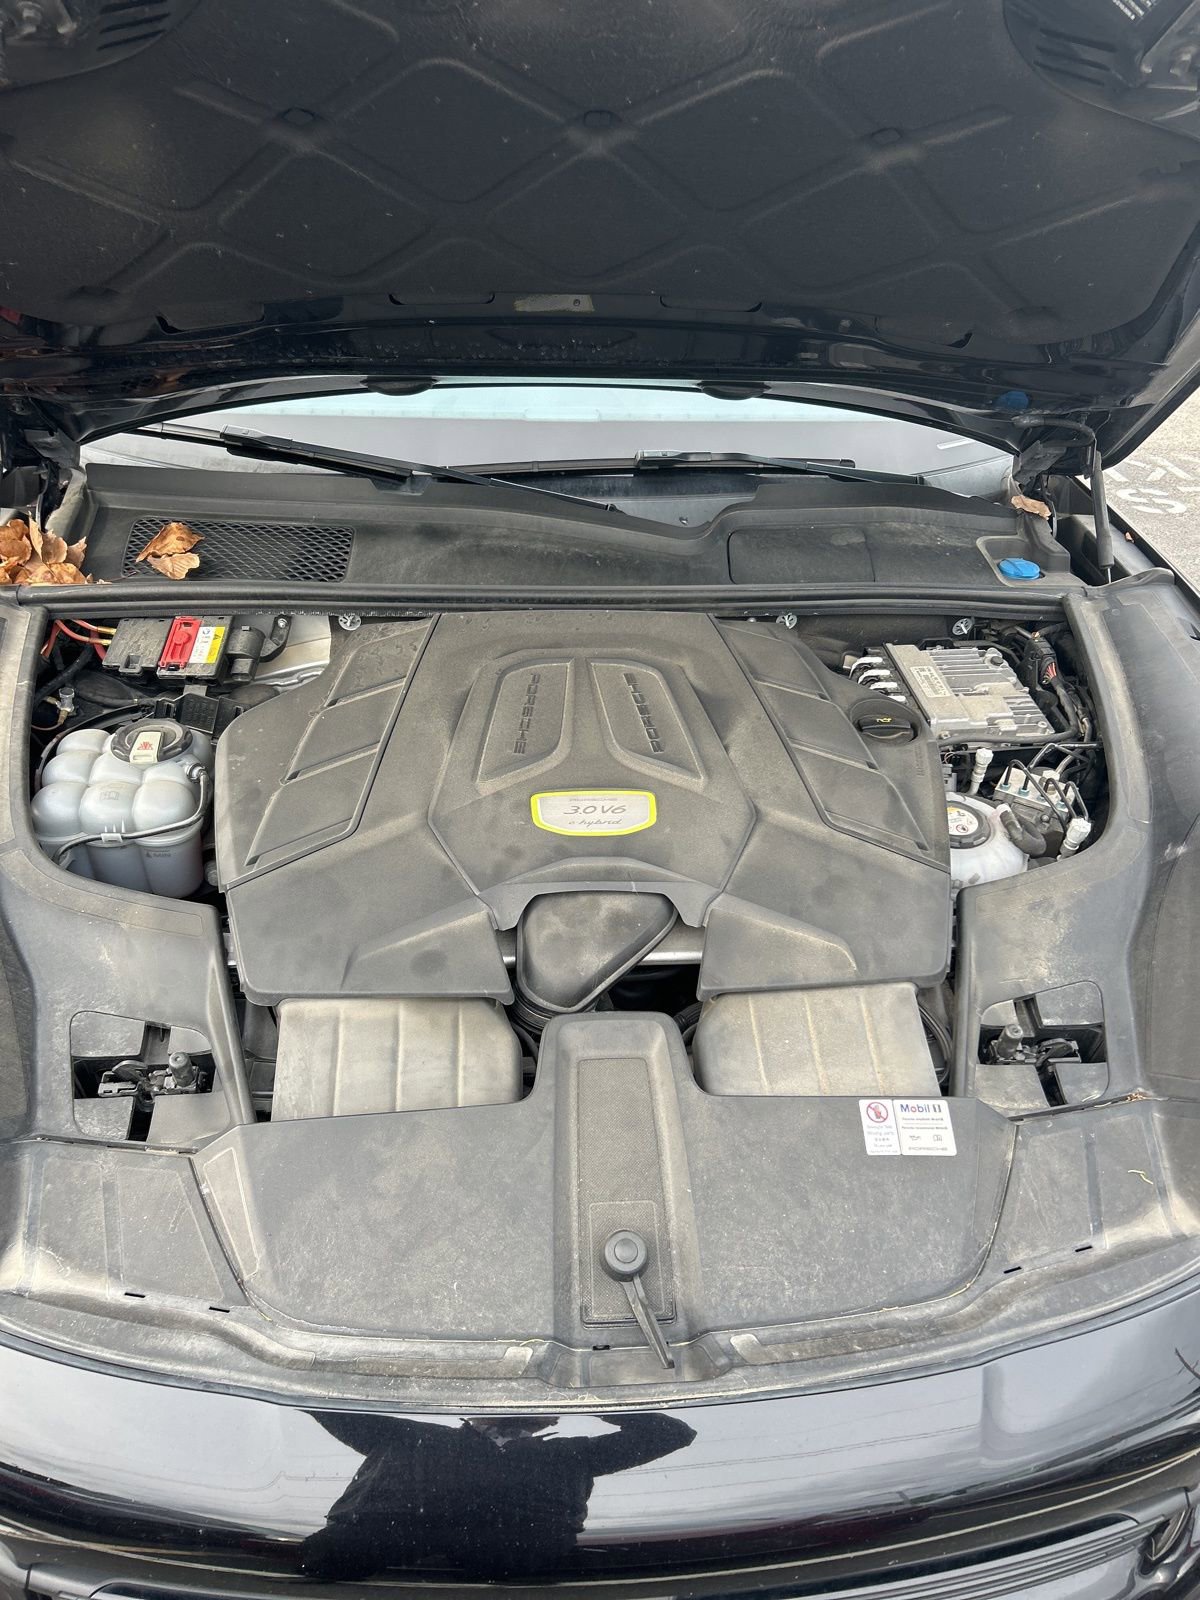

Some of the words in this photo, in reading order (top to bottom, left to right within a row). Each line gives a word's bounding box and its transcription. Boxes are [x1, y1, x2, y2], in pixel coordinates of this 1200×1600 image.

[514, 673, 541, 754] PORSCHE
[623, 673, 664, 754] PORSCHE
[563, 805, 597, 815] 3.0
[601, 804, 627, 815] V6
[900, 1104, 931, 1112] Mobil
